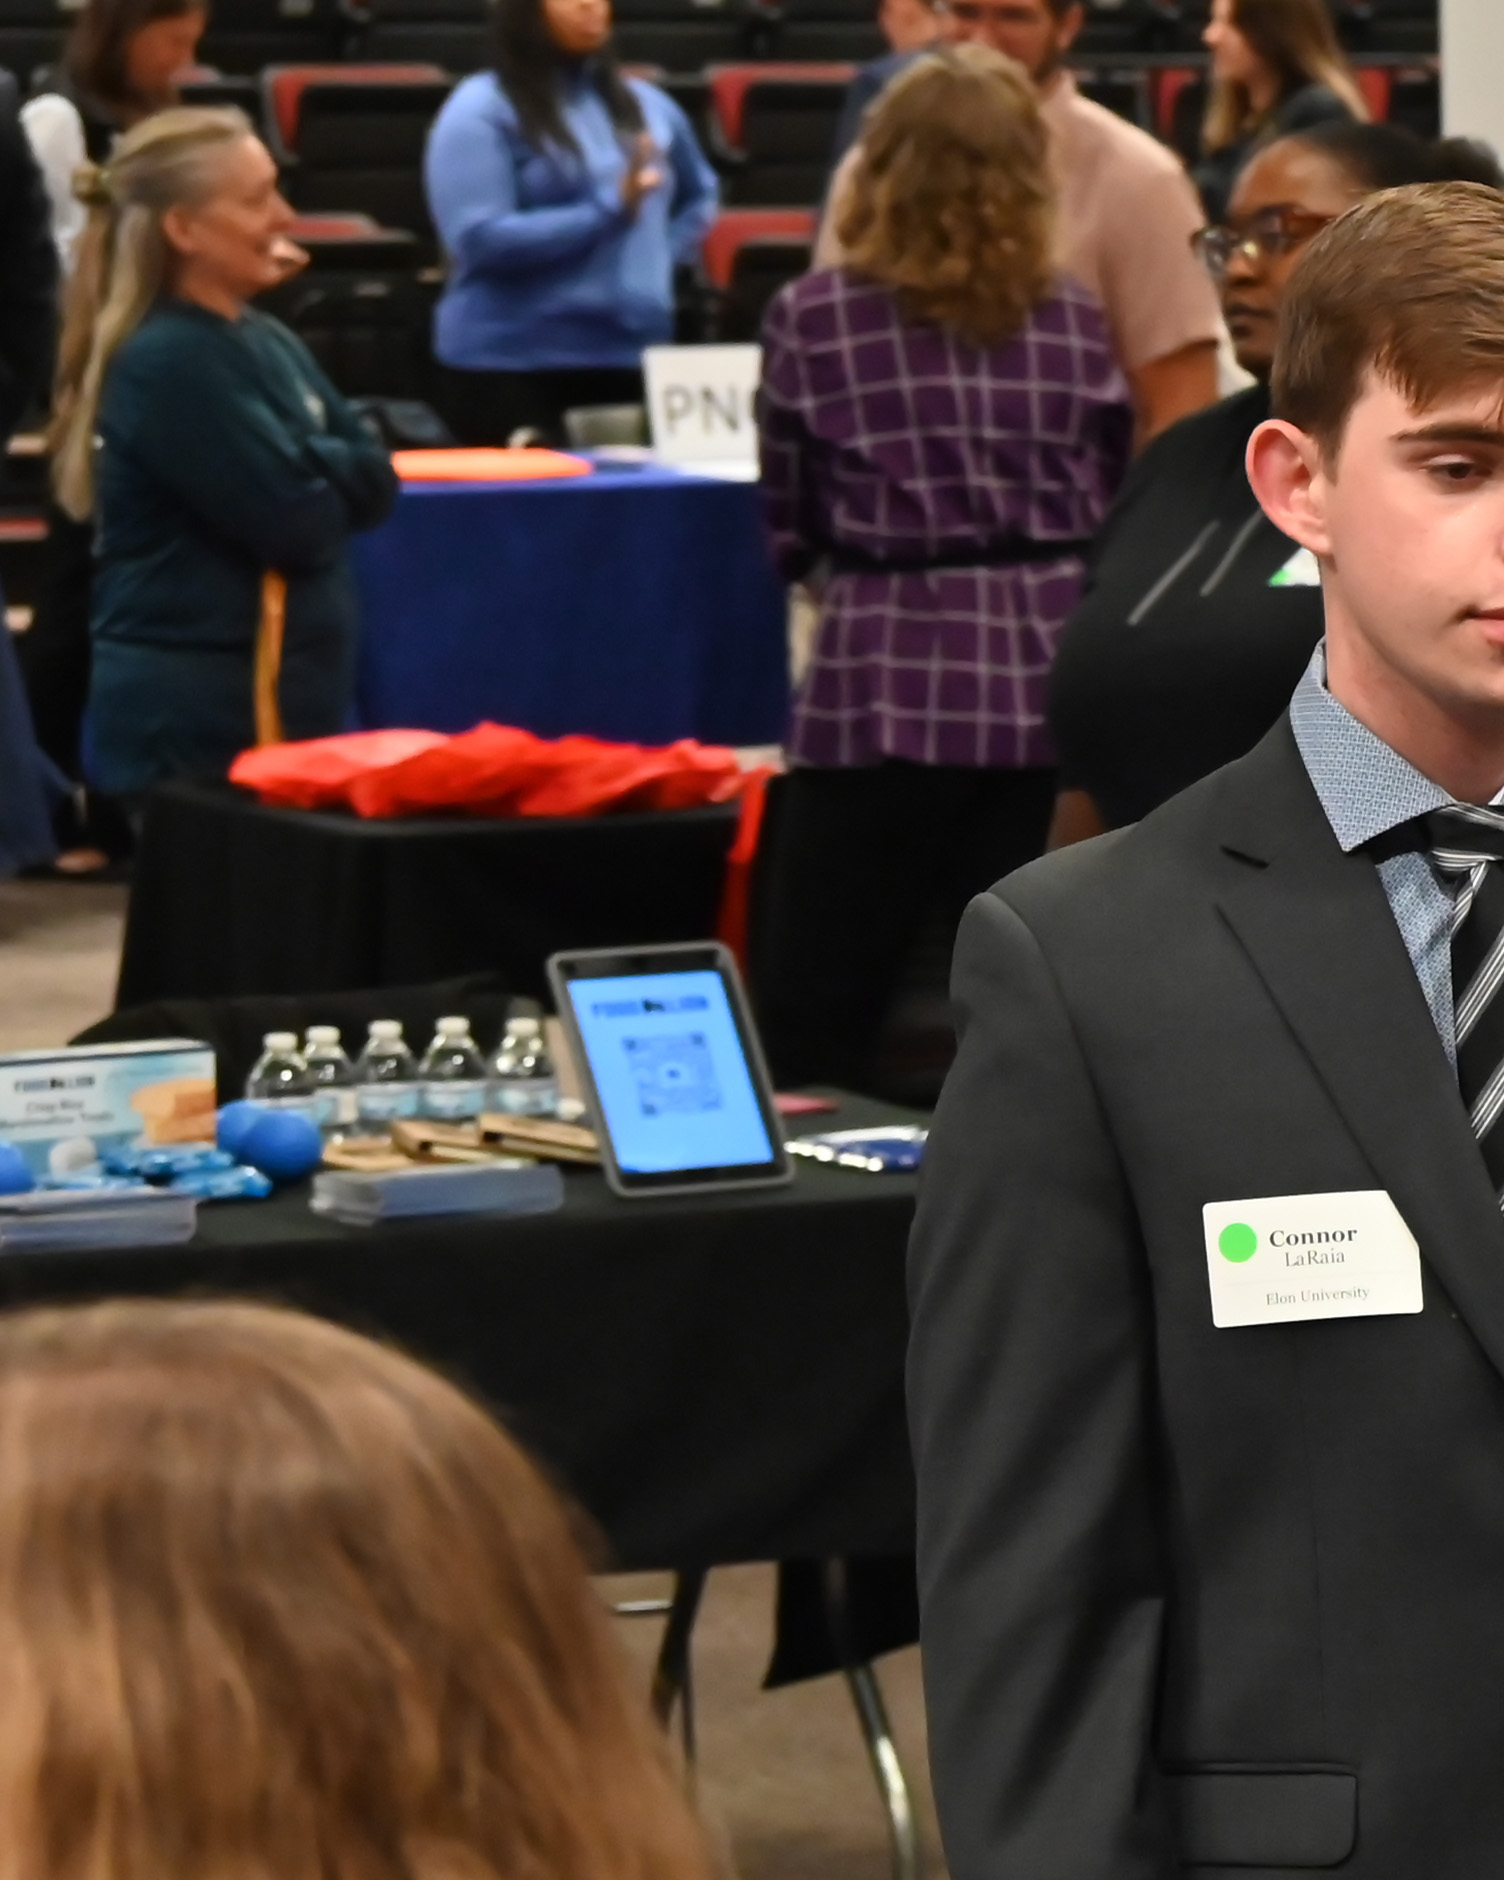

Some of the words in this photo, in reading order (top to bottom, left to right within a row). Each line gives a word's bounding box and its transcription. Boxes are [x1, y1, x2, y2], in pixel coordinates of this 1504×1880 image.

[661, 382, 758, 437] PN
[1269, 1229, 1358, 1248] Connor
[1284, 1247, 1346, 1268] LaRaia
[1265, 1292, 1297, 1306] Elon
[1300, 1286, 1371, 1303] University
